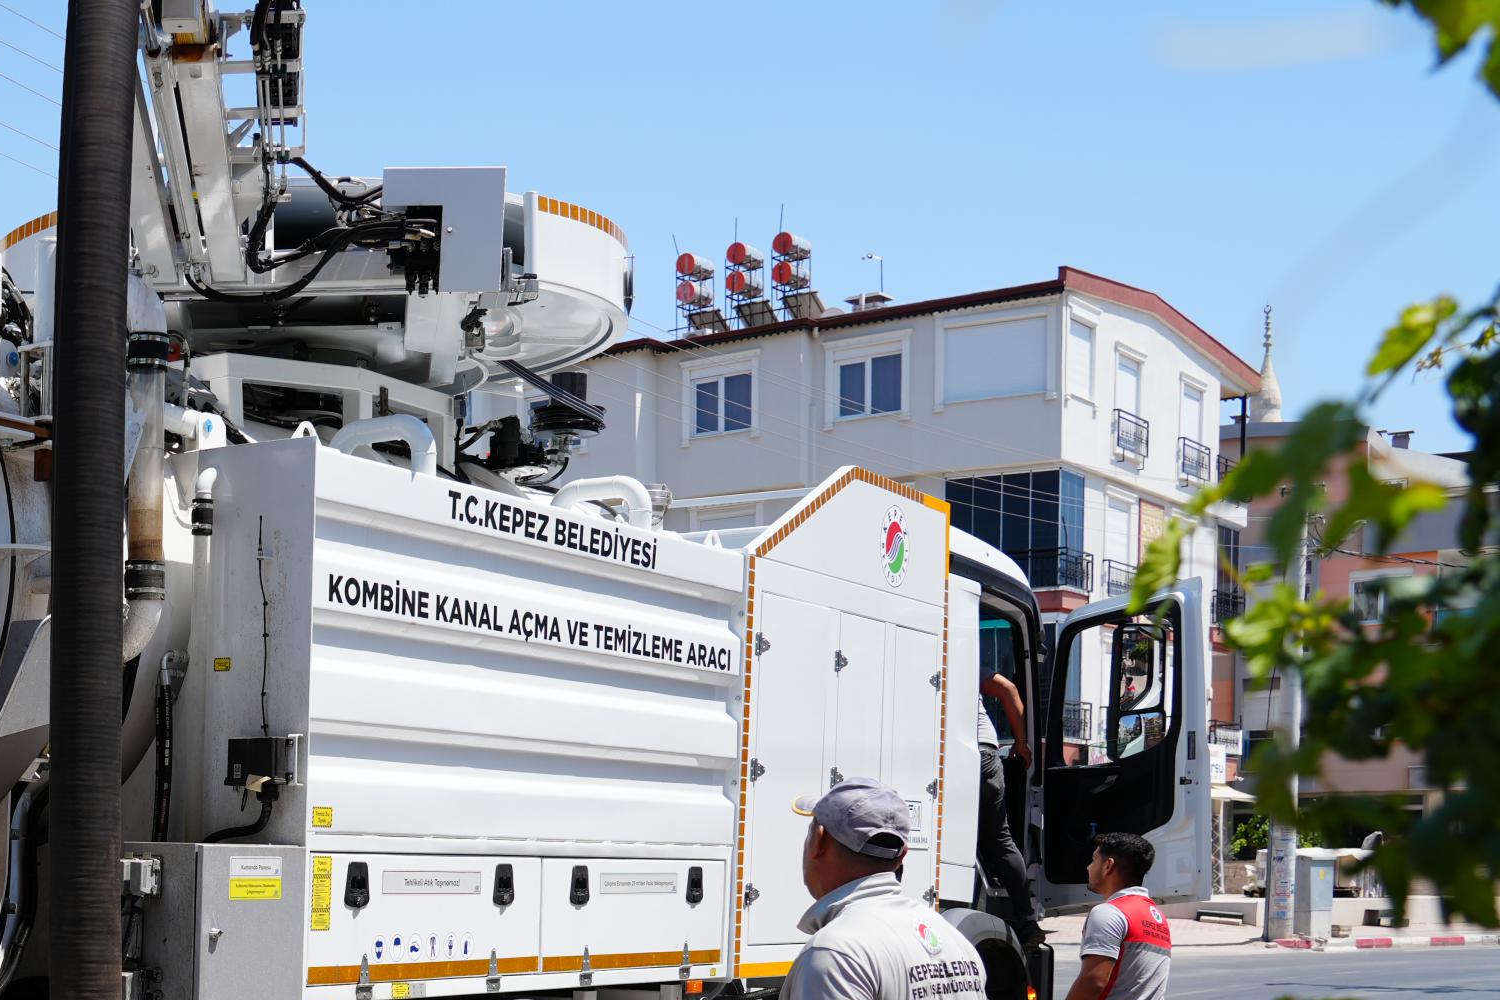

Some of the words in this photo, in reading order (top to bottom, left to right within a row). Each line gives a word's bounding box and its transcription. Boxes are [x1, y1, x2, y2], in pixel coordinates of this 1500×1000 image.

[448, 490, 549, 543] T.C.KEPEZ
[554, 520, 658, 570] BELEDİYESİ
[328, 573, 429, 619] KOMBİNE
[435, 594, 503, 633] KANAL
[508, 608, 561, 643] AÇMA
[566, 620, 589, 647] VE
[593, 623, 683, 663] TEMİZLEME
[686, 642, 731, 672] ARACI
[404, 878, 423, 887] Tehlikeli
[424, 878, 433, 887] Atık
